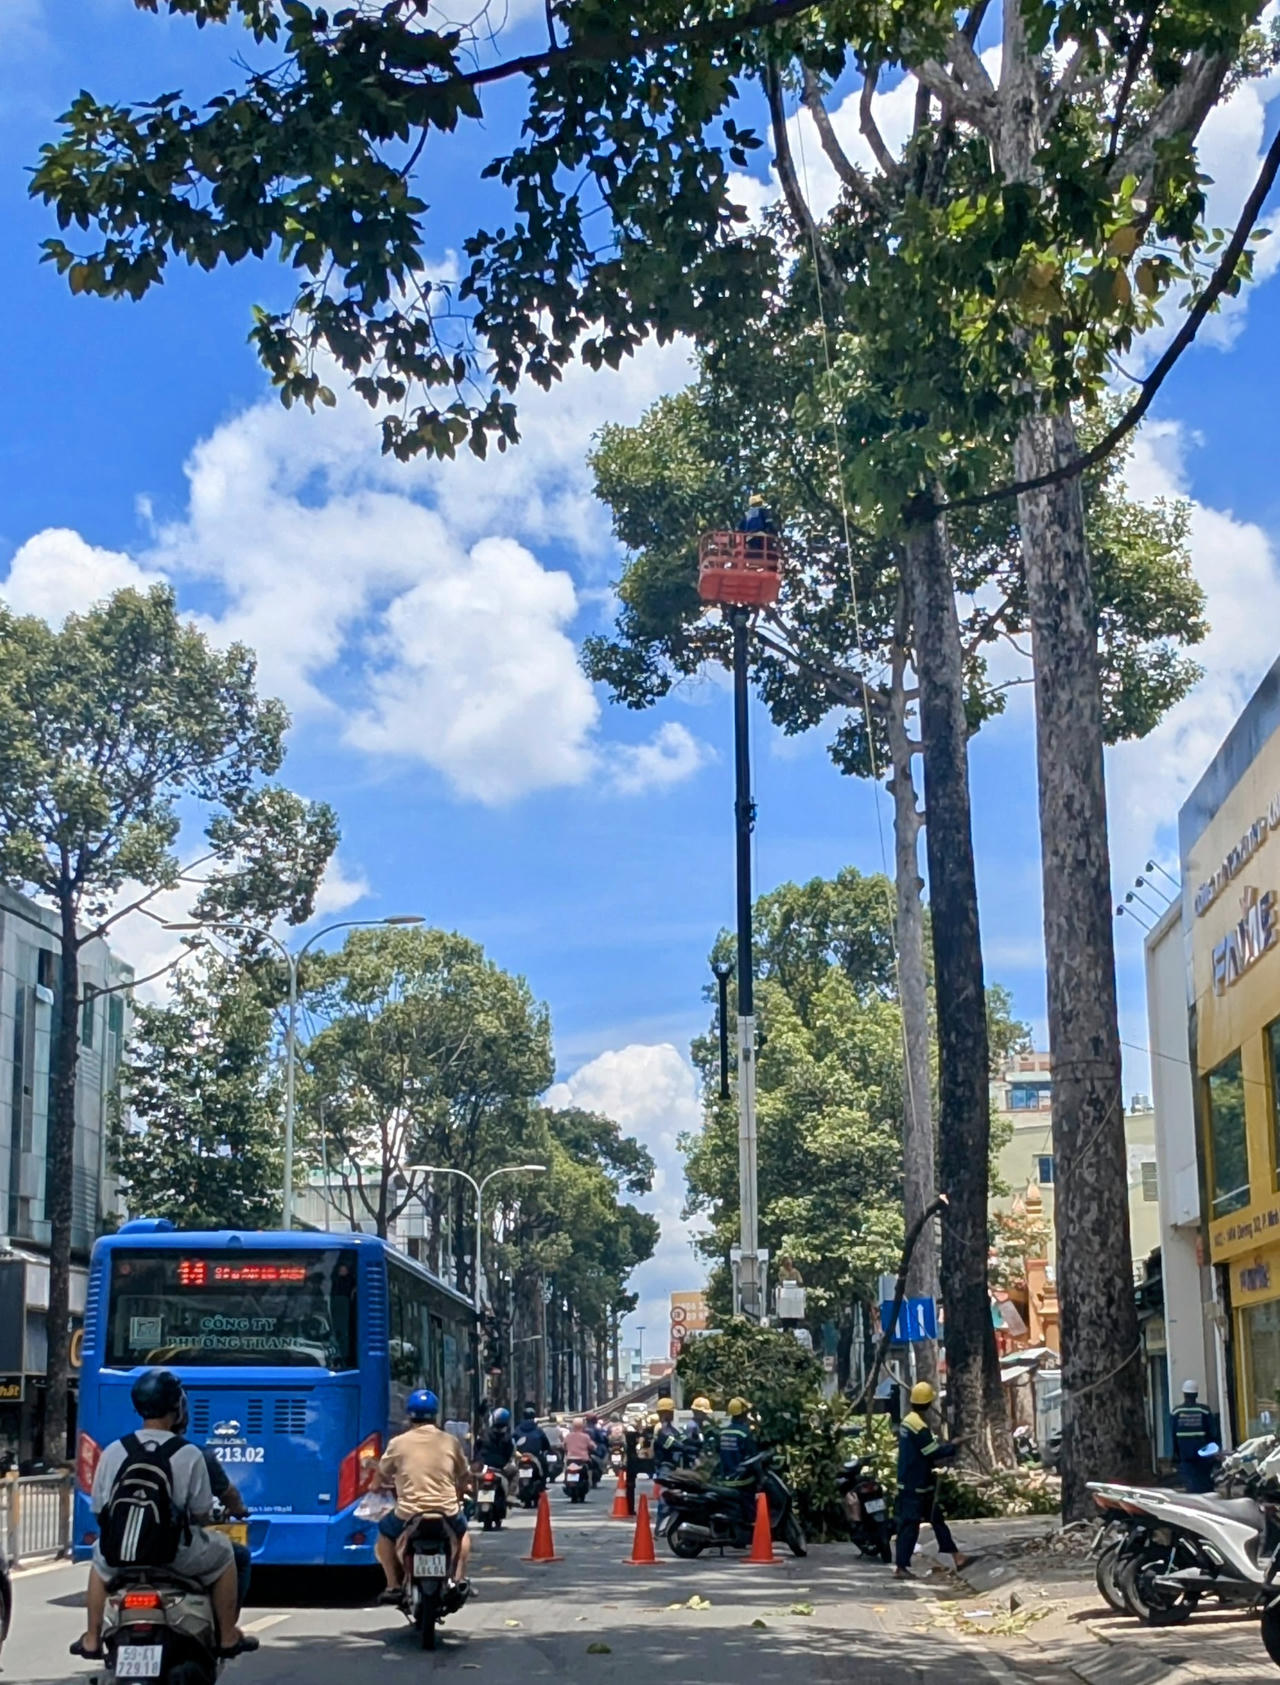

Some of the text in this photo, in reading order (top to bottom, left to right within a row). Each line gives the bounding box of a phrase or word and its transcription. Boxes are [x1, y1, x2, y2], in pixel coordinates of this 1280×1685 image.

[201, 1314, 277, 1331] CÔNG TY
[214, 1446, 265, 1463] 213.02
